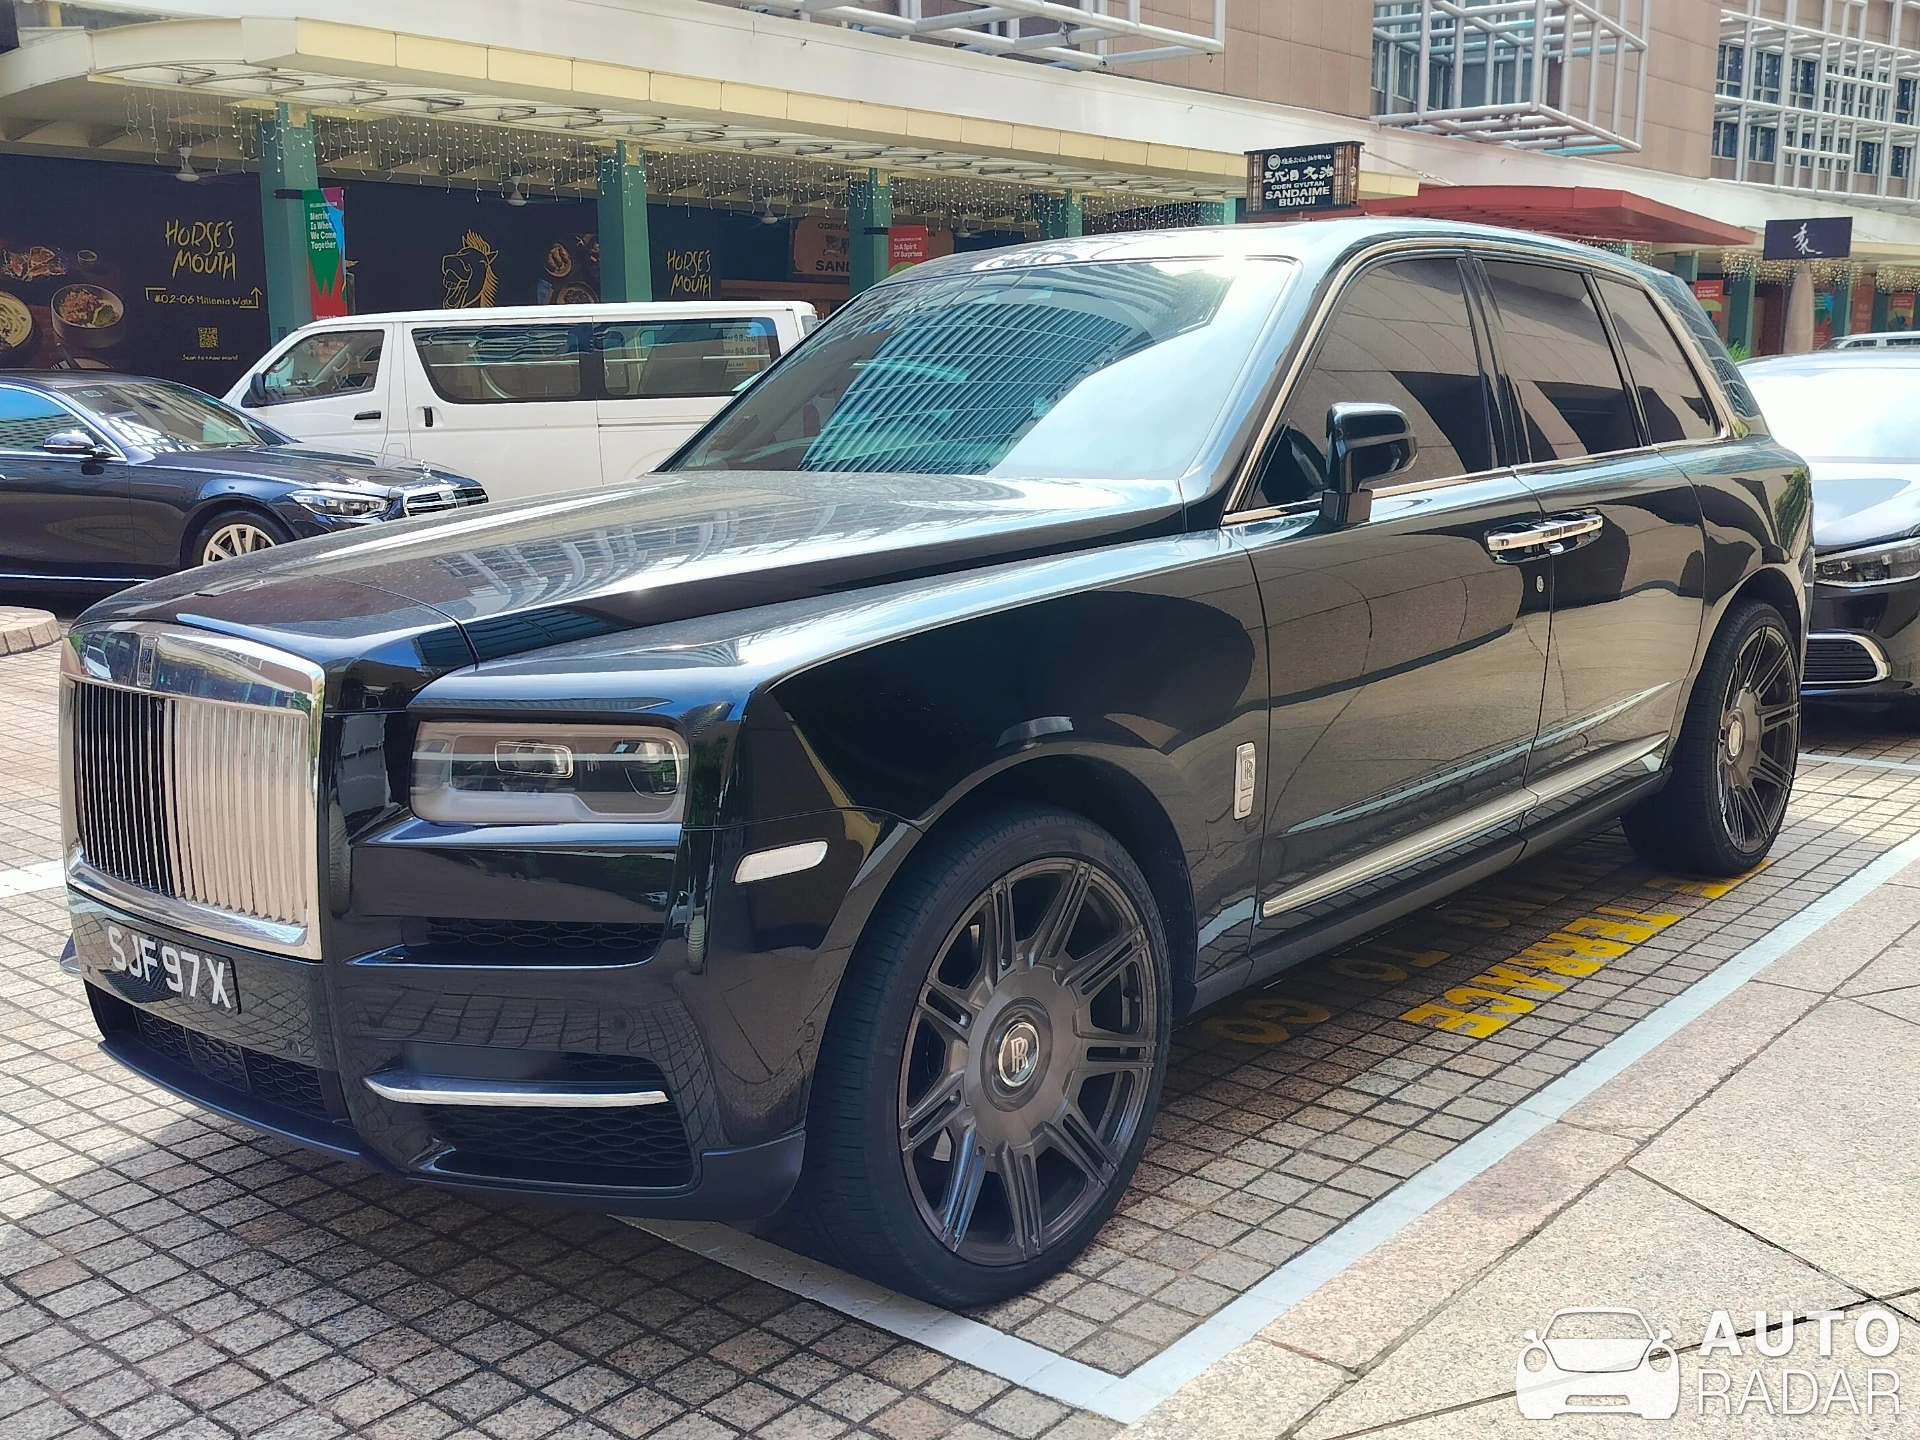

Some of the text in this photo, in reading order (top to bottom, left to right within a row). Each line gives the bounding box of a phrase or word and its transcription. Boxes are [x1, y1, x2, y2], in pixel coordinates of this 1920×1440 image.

[1265, 186, 1330, 200] SANDAIME
[1279, 196, 1316, 207] BUNJI
[310, 220, 333, 230] Is When
[817, 222, 841, 231] ODEN
[165, 219, 234, 256] HORSE'S
[310, 231, 337, 240] We Come
[310, 240, 337, 251] Together
[904, 243, 917, 251] Spirit
[172, 249, 236, 281] MOUTH
[667, 249, 711, 278] HORSE'S
[671, 273, 711, 298] MOUTH
[154, 294, 195, 304] #02-06
[196, 295, 231, 305] Millenia
[1399, 905, 1684, 1038] TERRACE
